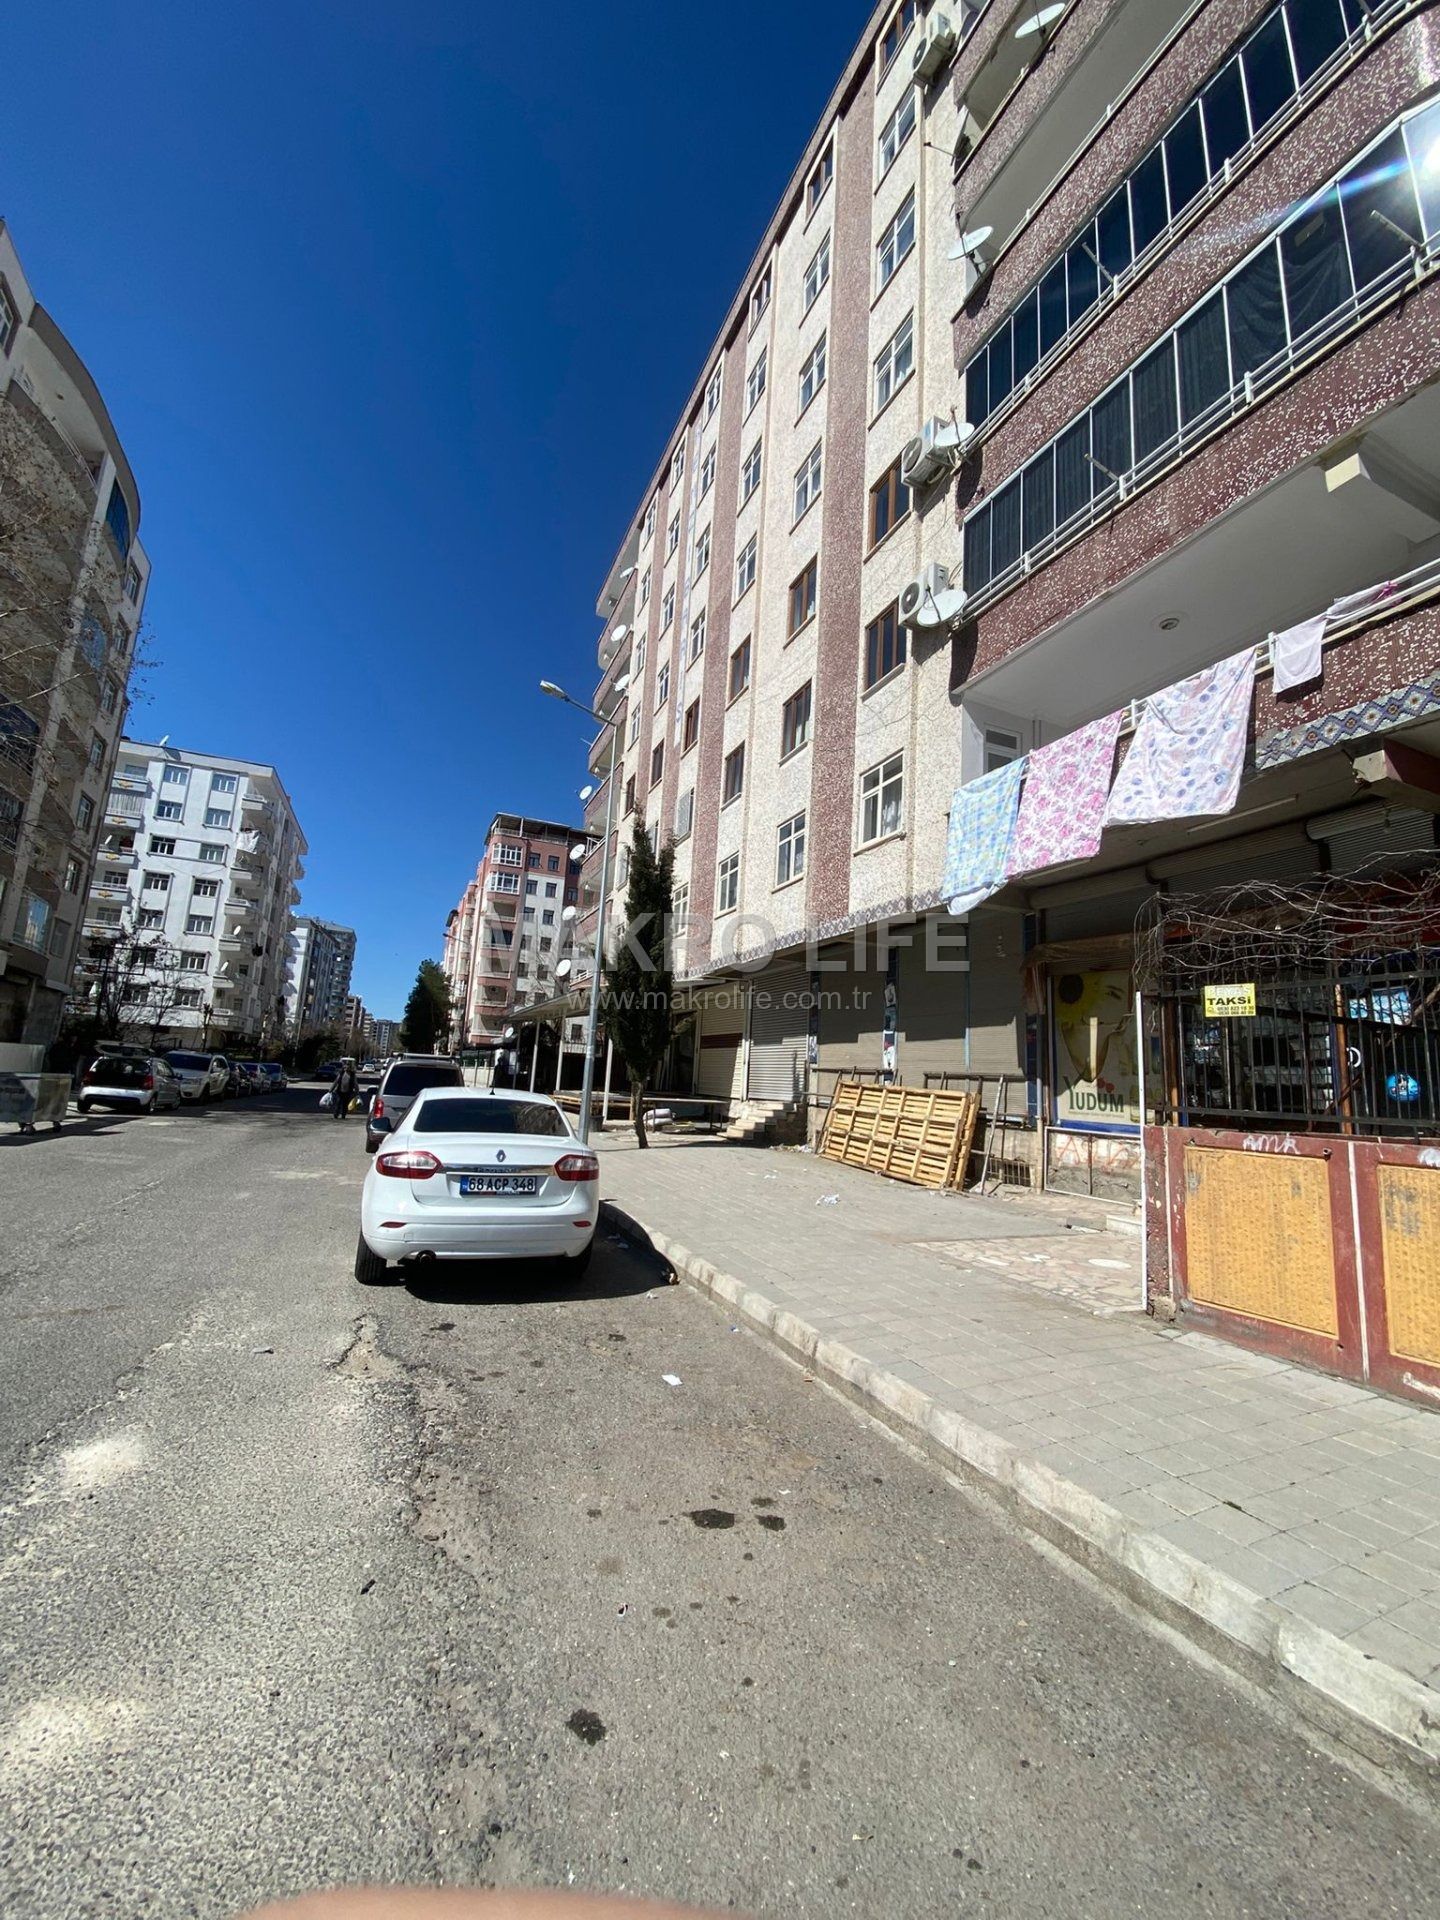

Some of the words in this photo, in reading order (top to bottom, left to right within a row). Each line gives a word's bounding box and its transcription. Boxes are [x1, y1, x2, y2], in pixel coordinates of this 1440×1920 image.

[1063, 1076, 1124, 1113] YUDUM
[469, 1177, 484, 1190] 68
[486, 1177, 509, 1190] ACP
[512, 1177, 534, 1190] 348
